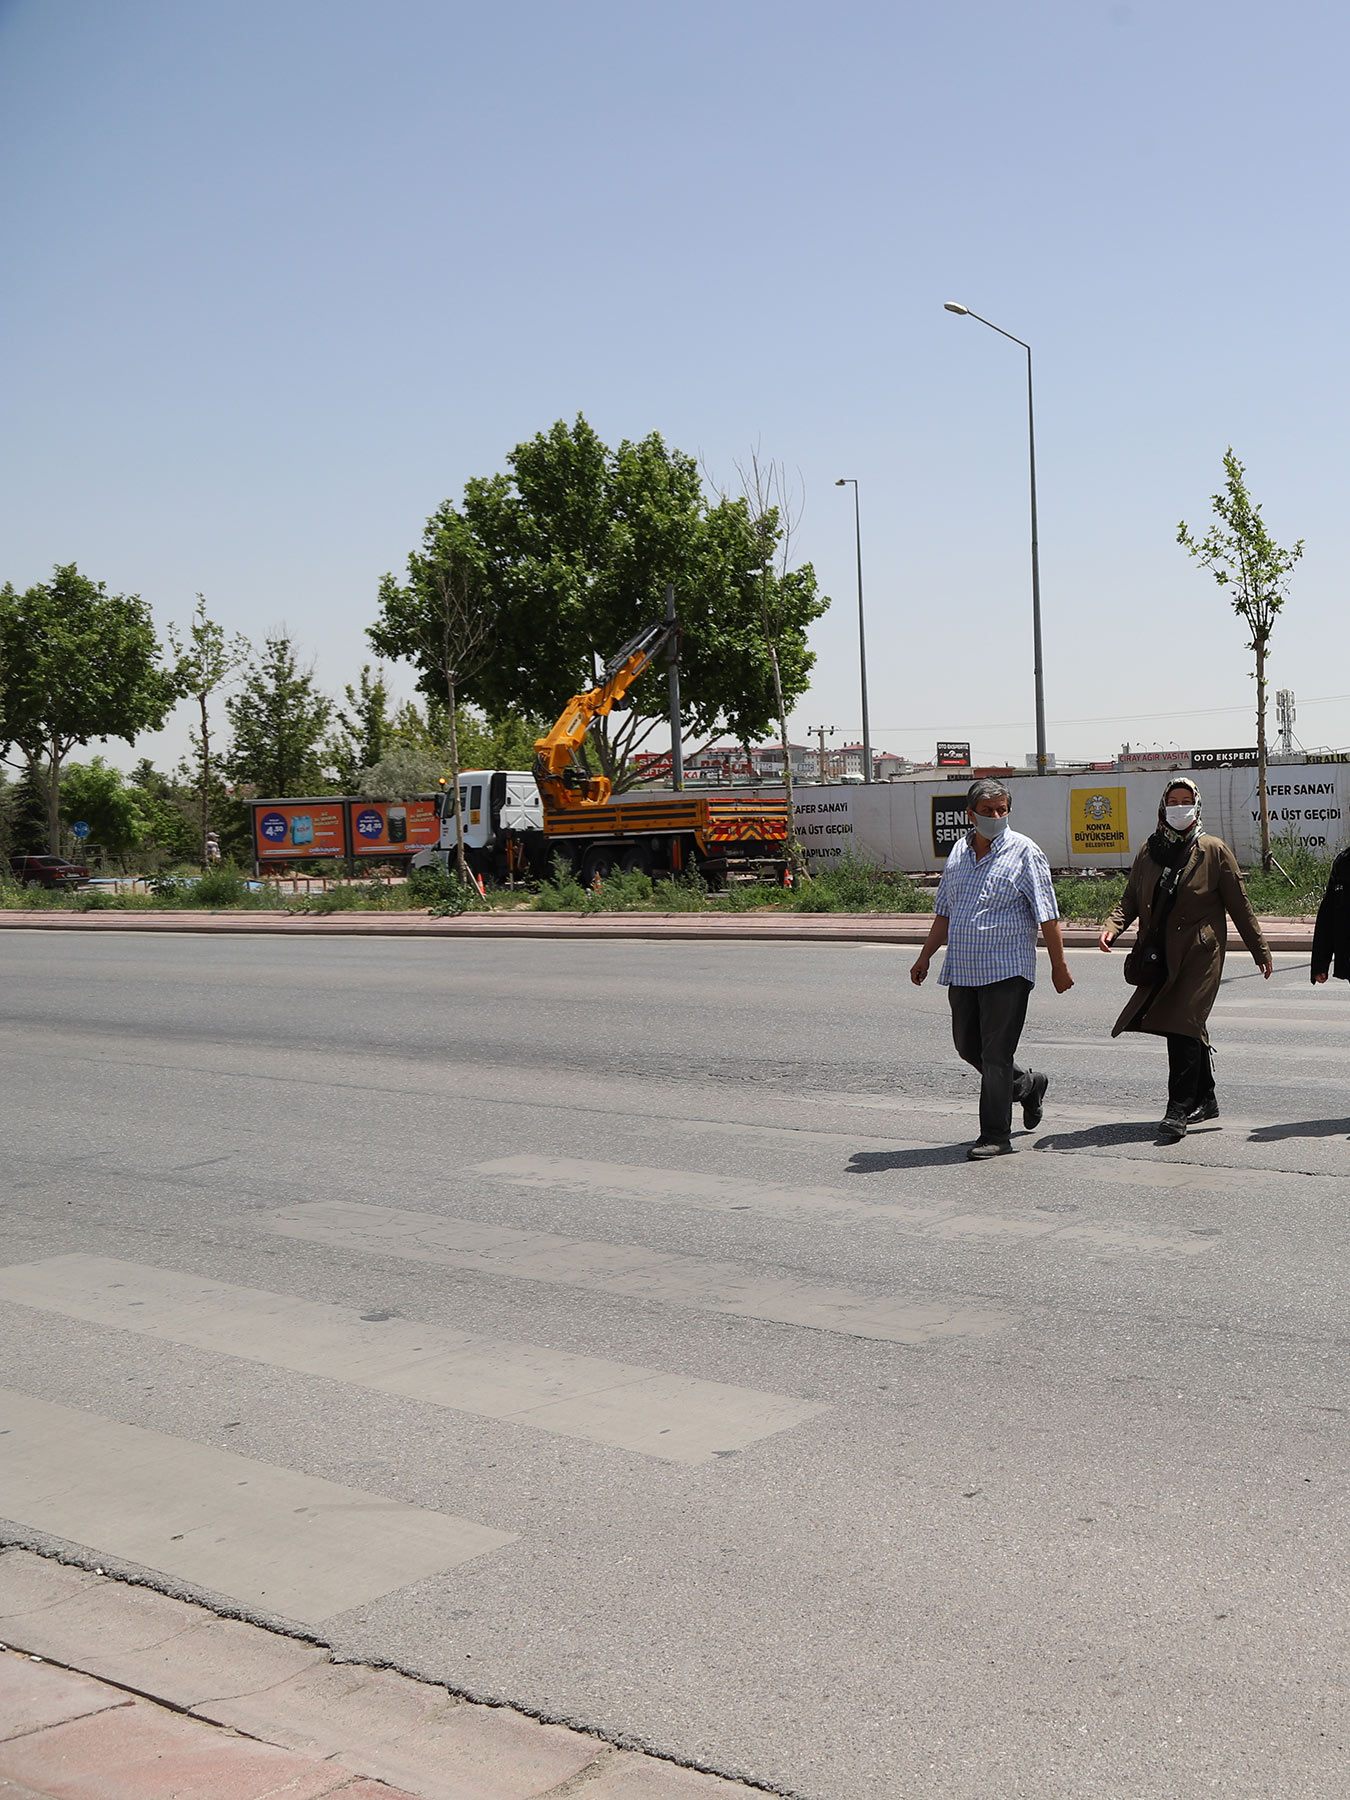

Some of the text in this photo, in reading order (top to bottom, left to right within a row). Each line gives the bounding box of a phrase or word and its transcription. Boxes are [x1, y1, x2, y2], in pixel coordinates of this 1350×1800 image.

[1162, 751, 1189, 760] VASITA
[1216, 751, 1259, 760] EKSPERTİ
[1293, 783, 1334, 795] SANAYİ
[793, 802, 848, 814] AFER SANAYİ
[1281, 807, 1301, 821] ÜST
[1304, 808, 1341, 821] GEÇİDİ
[935, 810, 968, 826] BENİ
[795, 823, 853, 836] YA ÜST GEÇİDİ
[1086, 823, 1112, 831] KONYA
[935, 827, 970, 844] ŞEHR
[1074, 830, 1125, 841] BÜYÜKŞEHİR
